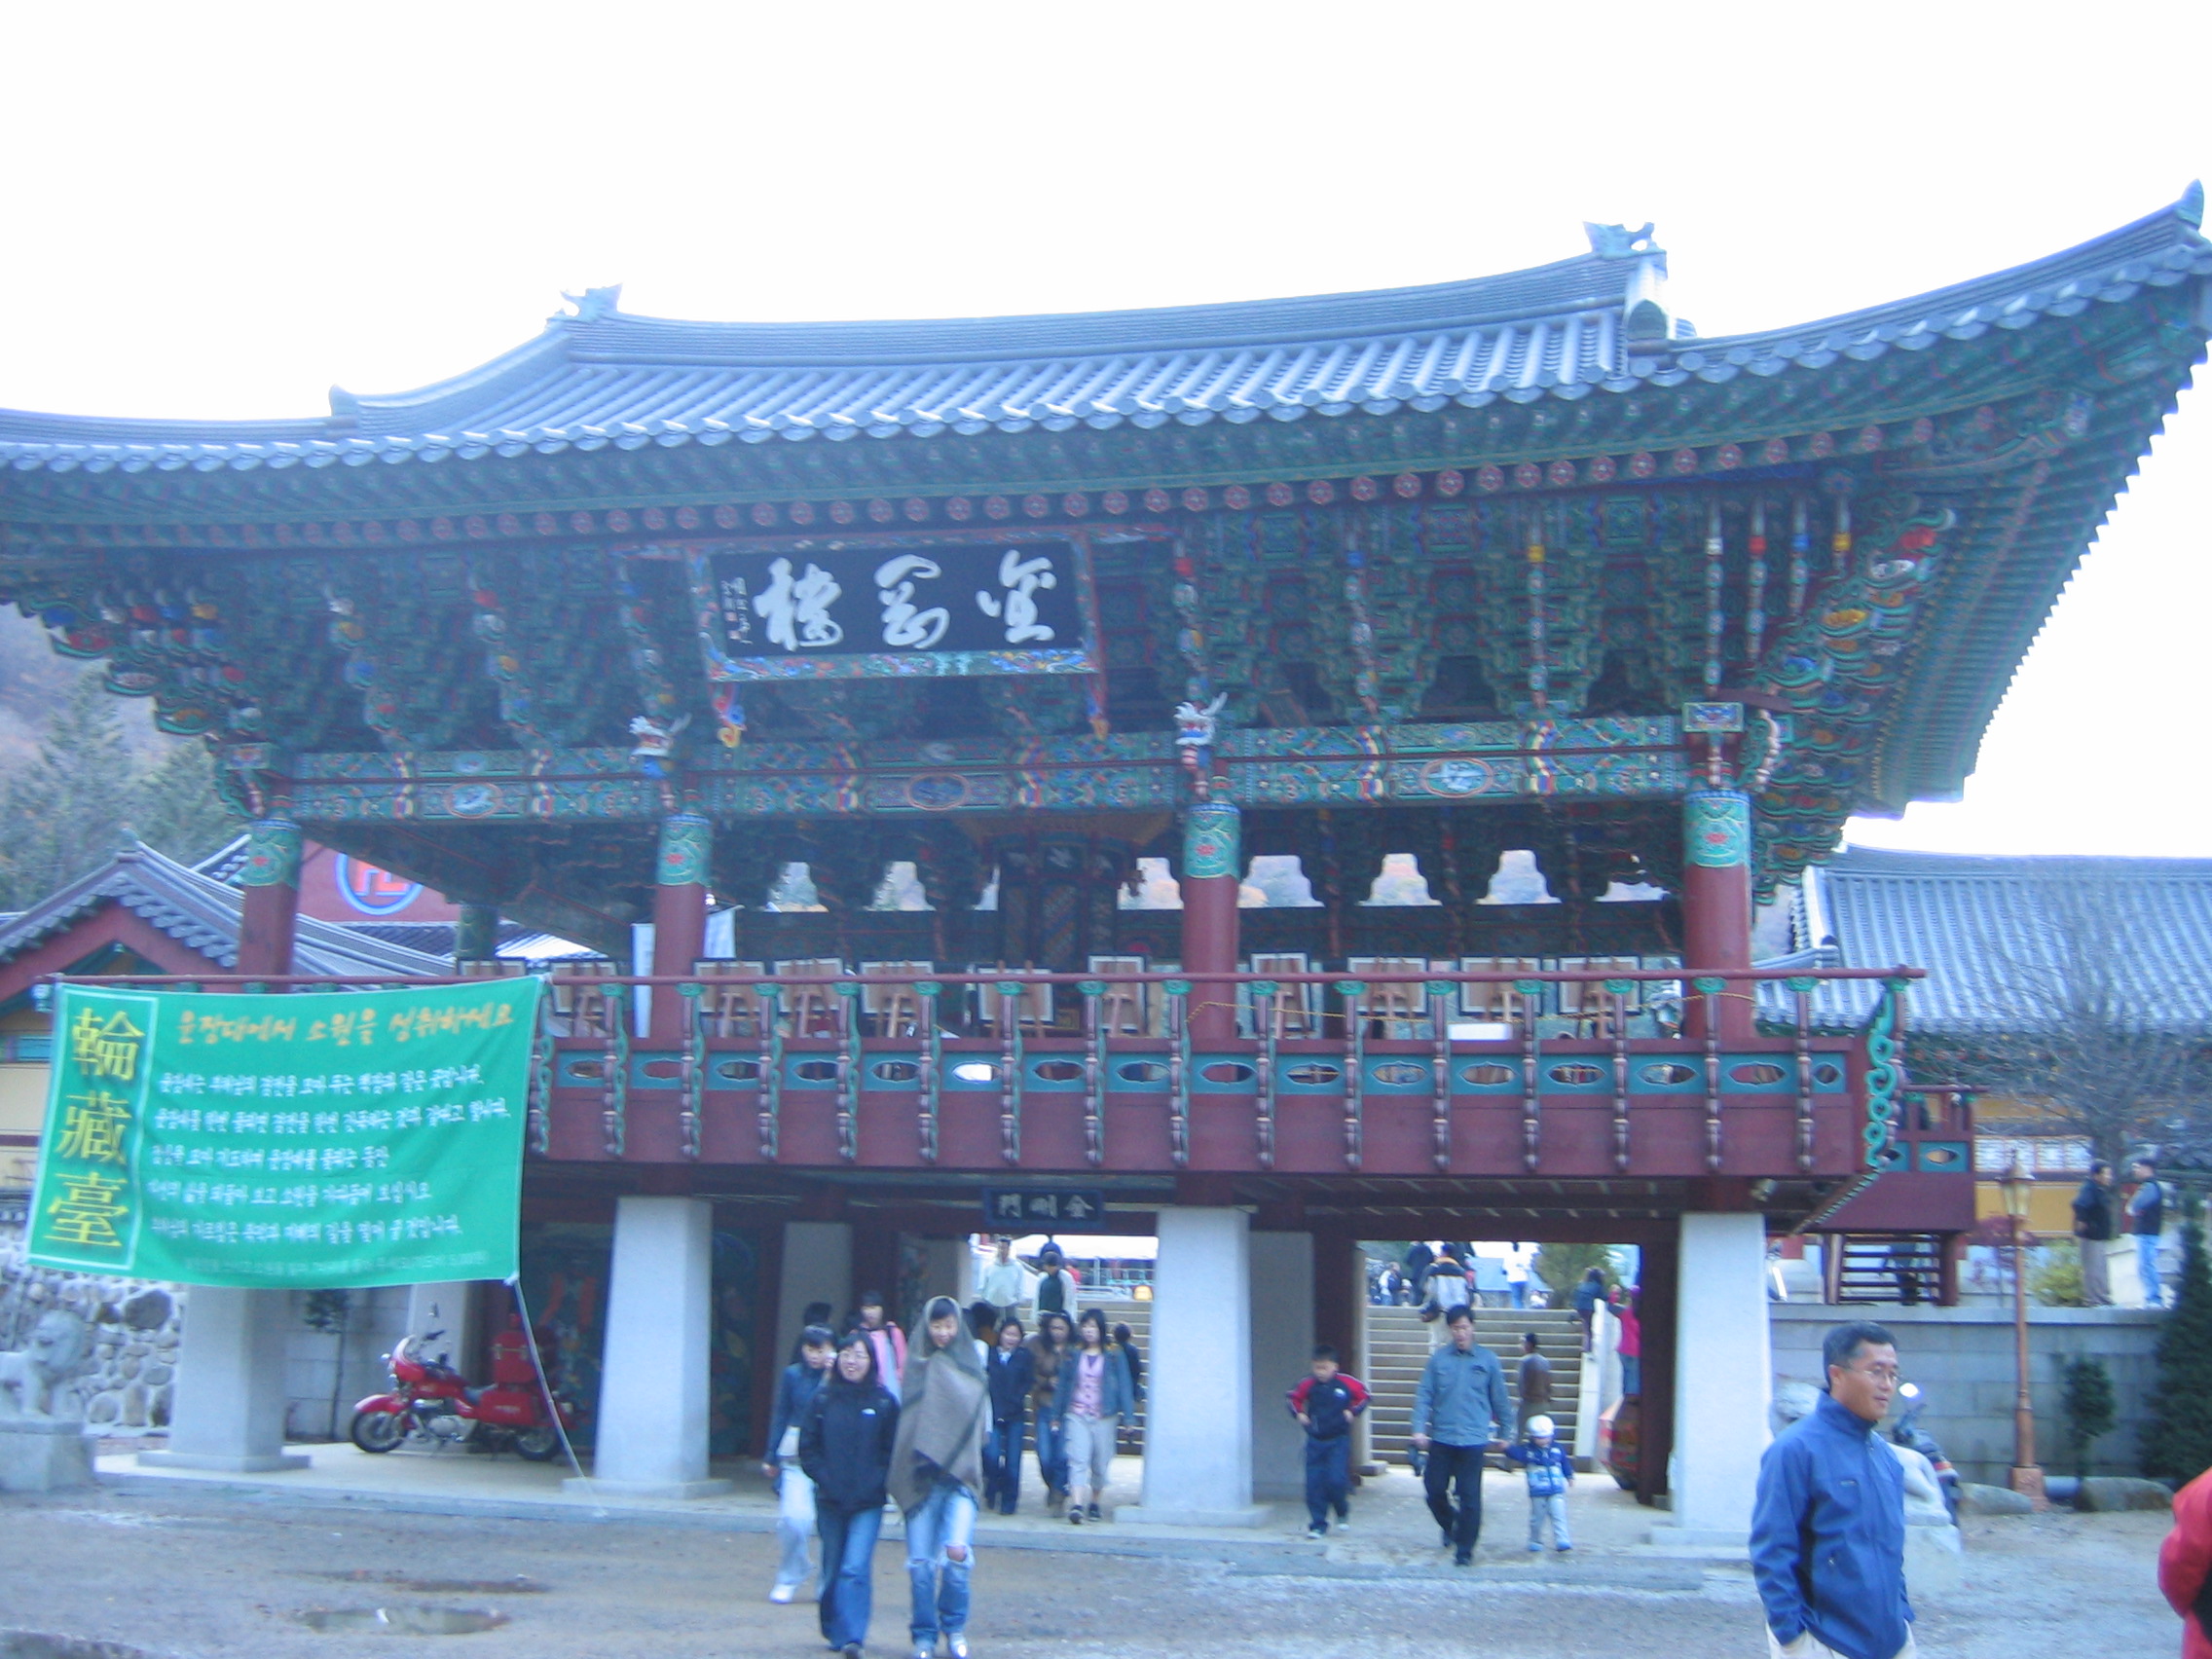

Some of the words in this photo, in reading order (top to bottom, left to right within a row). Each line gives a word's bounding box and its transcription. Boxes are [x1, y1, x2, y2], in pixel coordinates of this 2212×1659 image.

[305, 1009, 378, 1047] 소원을
[389, 1002, 514, 1043] 성취하세요
[46, 1006, 146, 1249] 輪藏臺
